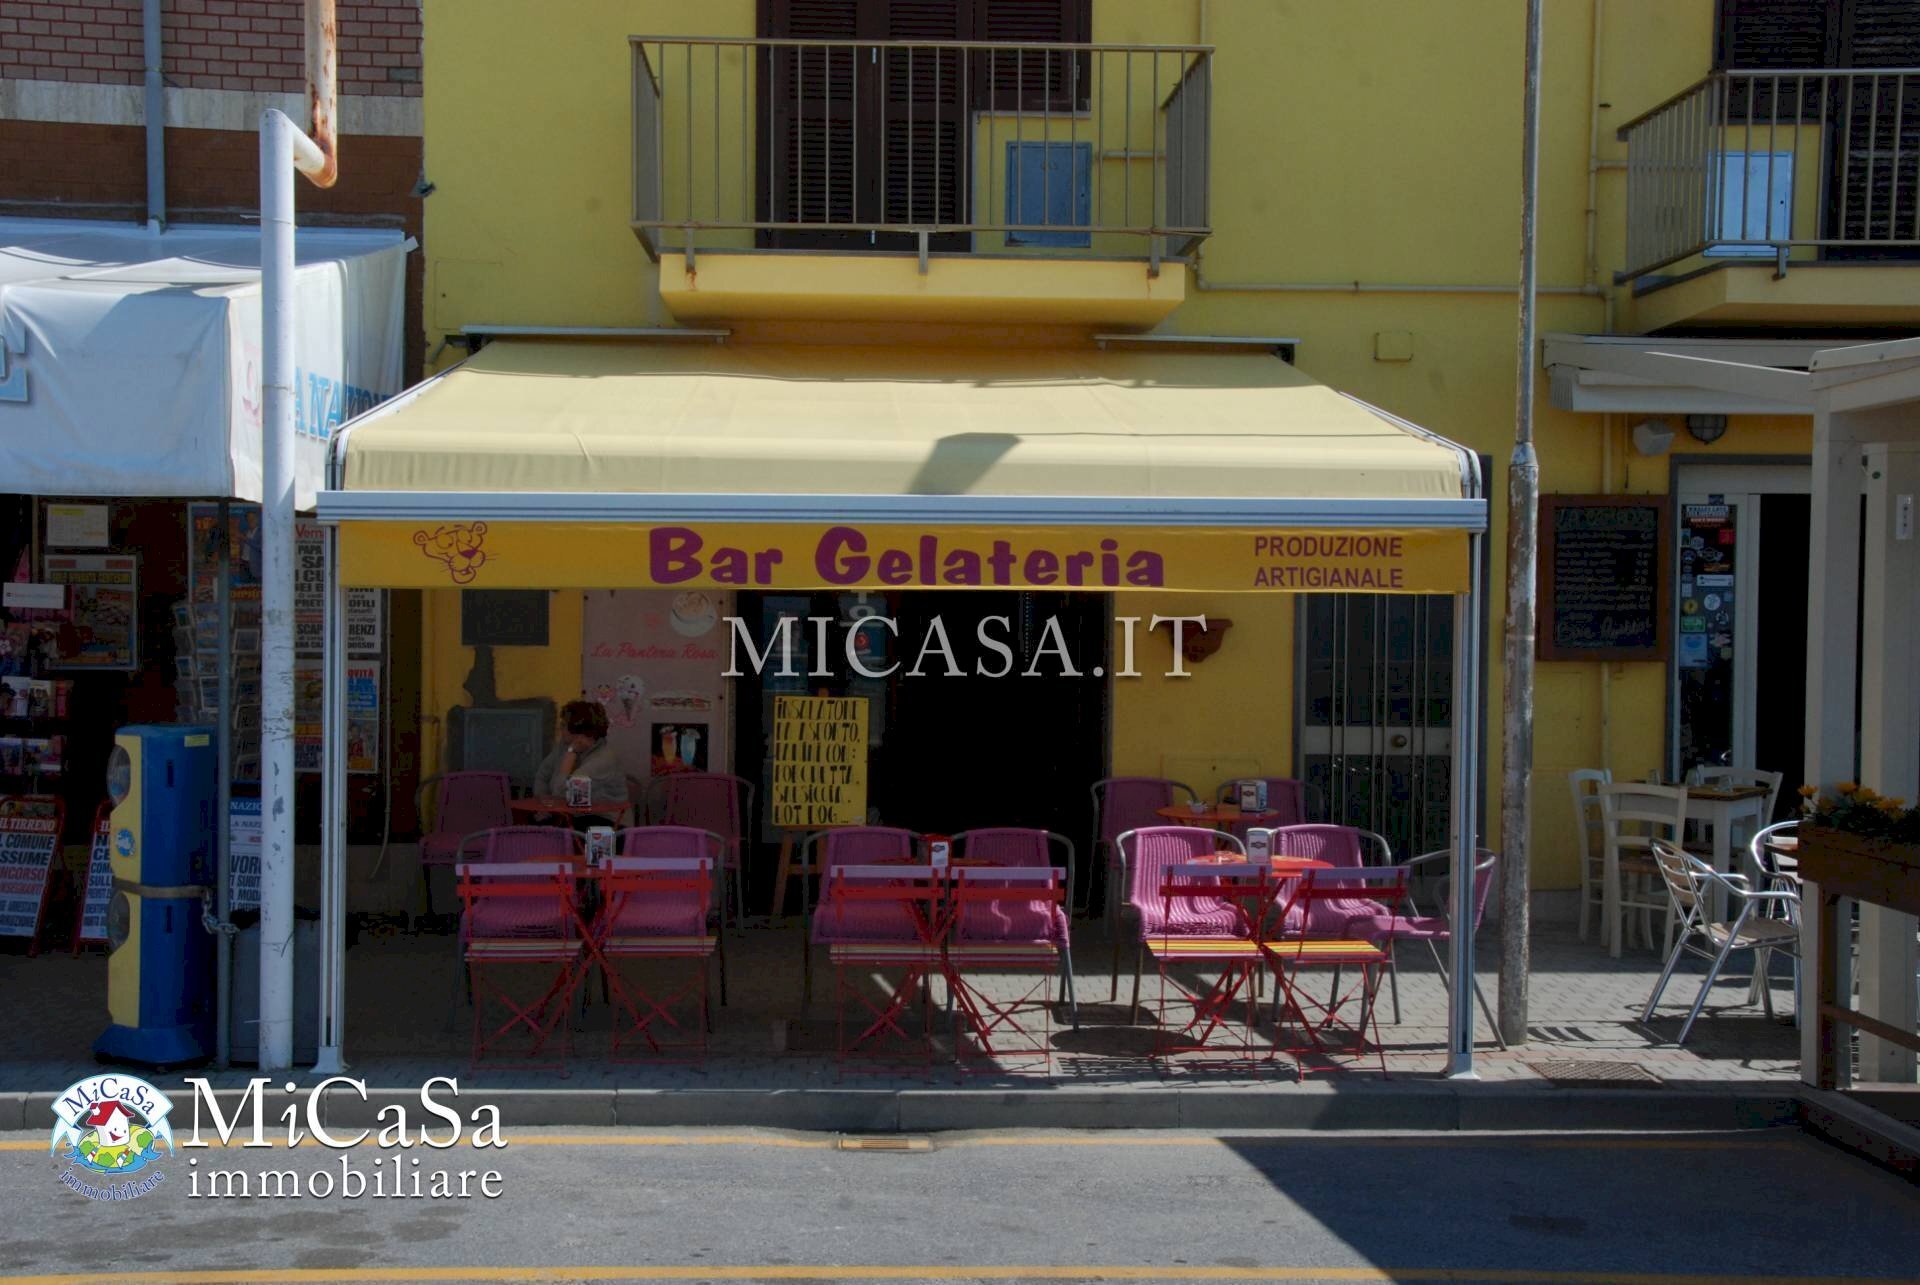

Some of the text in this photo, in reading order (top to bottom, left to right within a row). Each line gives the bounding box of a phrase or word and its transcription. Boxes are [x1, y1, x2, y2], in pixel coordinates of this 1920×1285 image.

[649, 526, 1164, 587] Bar Gelateria
[1254, 536, 1404, 557] PRODUZIONE
[1253, 567, 1404, 588] ARTIGIANALE
[10, 818, 56, 832] TIRRENO
[5, 834, 55, 850] COMUNE
